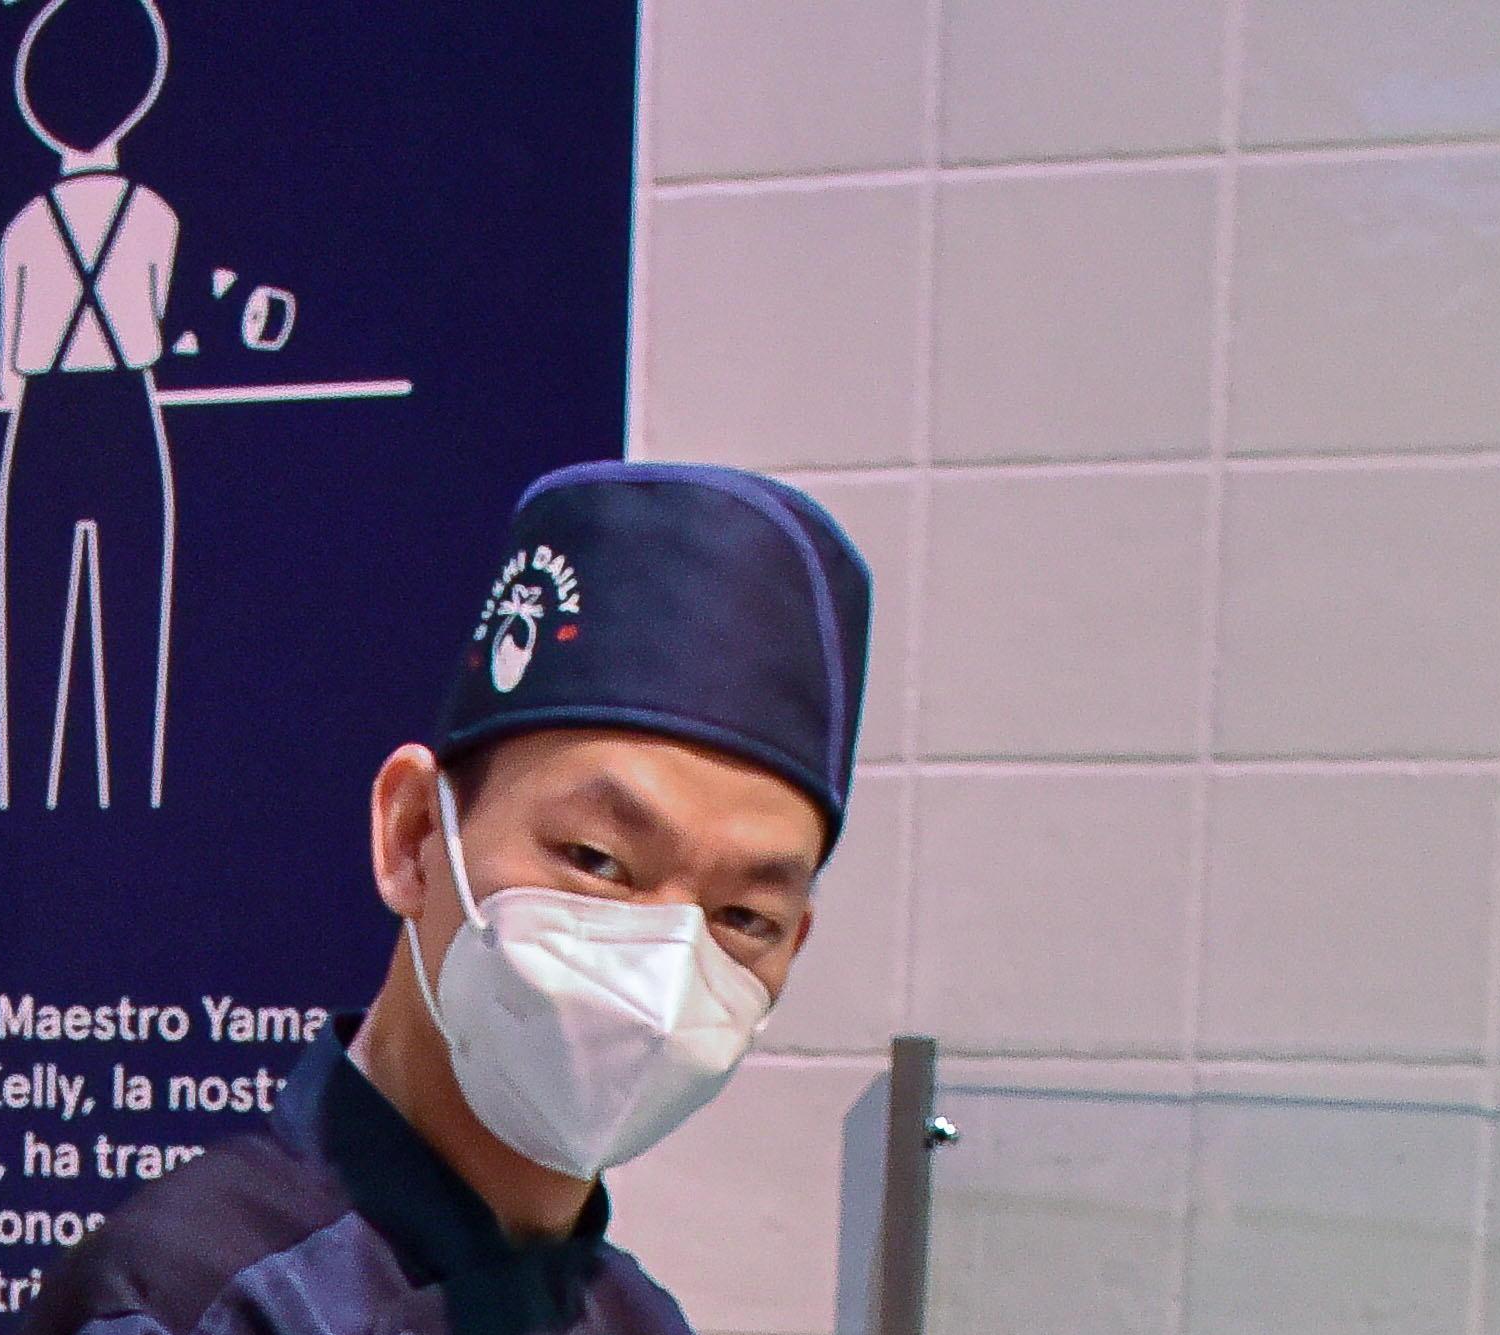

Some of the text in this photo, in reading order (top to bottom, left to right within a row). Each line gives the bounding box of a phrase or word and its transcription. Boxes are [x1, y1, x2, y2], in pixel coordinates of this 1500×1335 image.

[531, 544, 581, 614] DAILY
[113, 1064, 152, 1111] la
[169, 1067, 288, 1113] nost
[23, 1131, 81, 1179] ha
